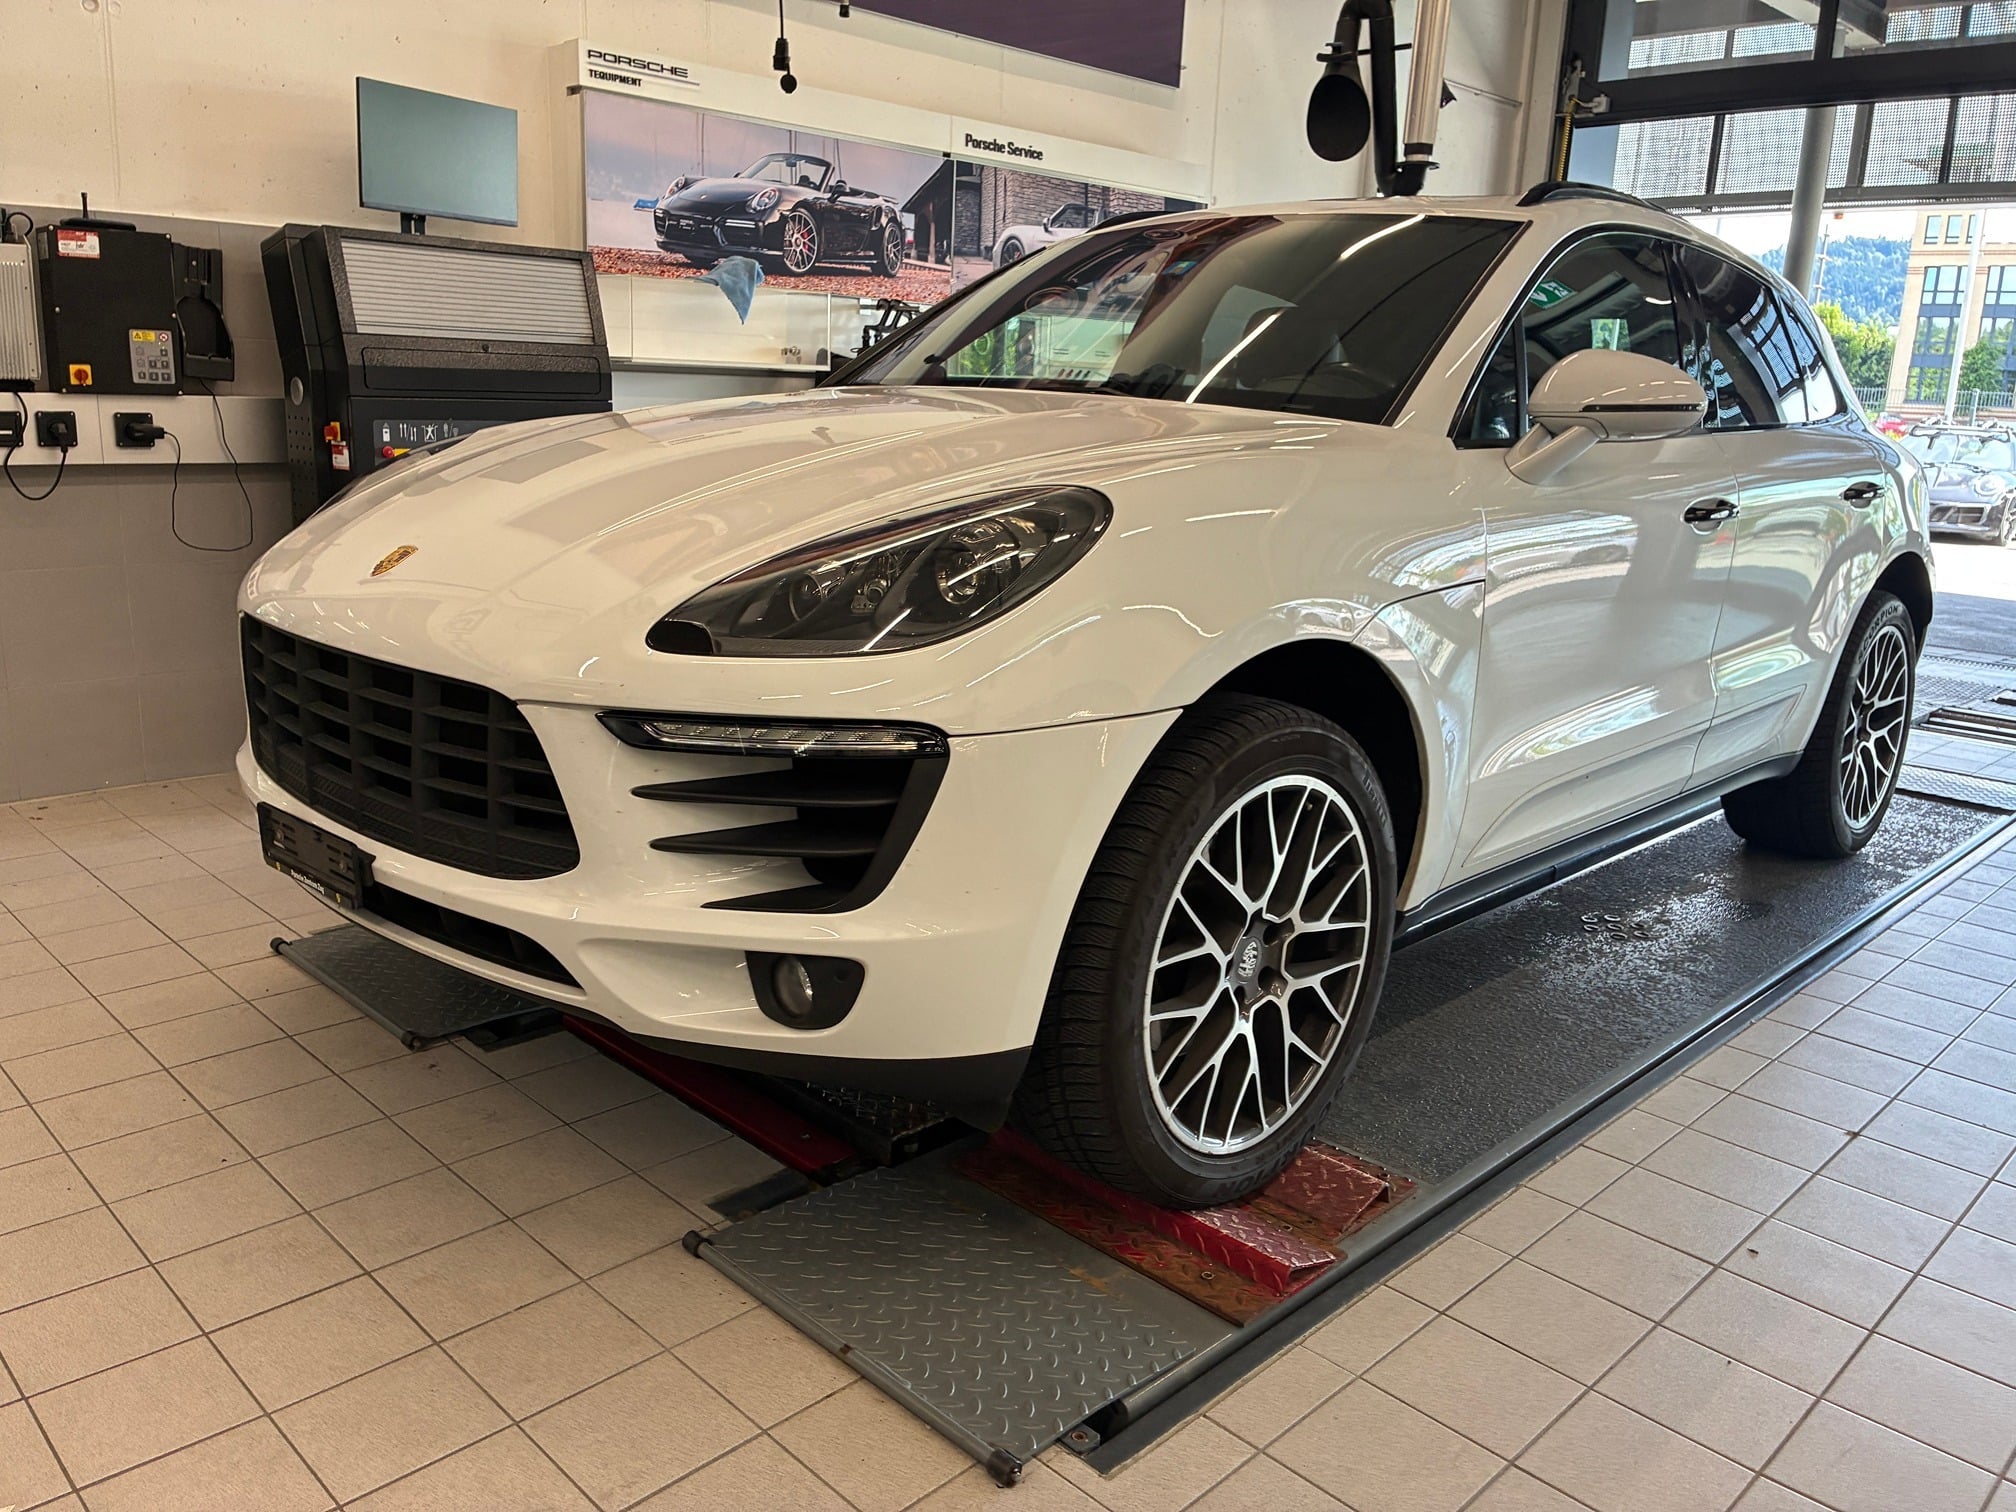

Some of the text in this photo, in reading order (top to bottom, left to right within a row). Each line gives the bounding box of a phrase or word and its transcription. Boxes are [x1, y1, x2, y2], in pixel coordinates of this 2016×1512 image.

[587, 49, 689, 79] PORSCHE
[588, 69, 642, 87] TEQUIPMENT
[965, 133, 1043, 160] Porsche Service
